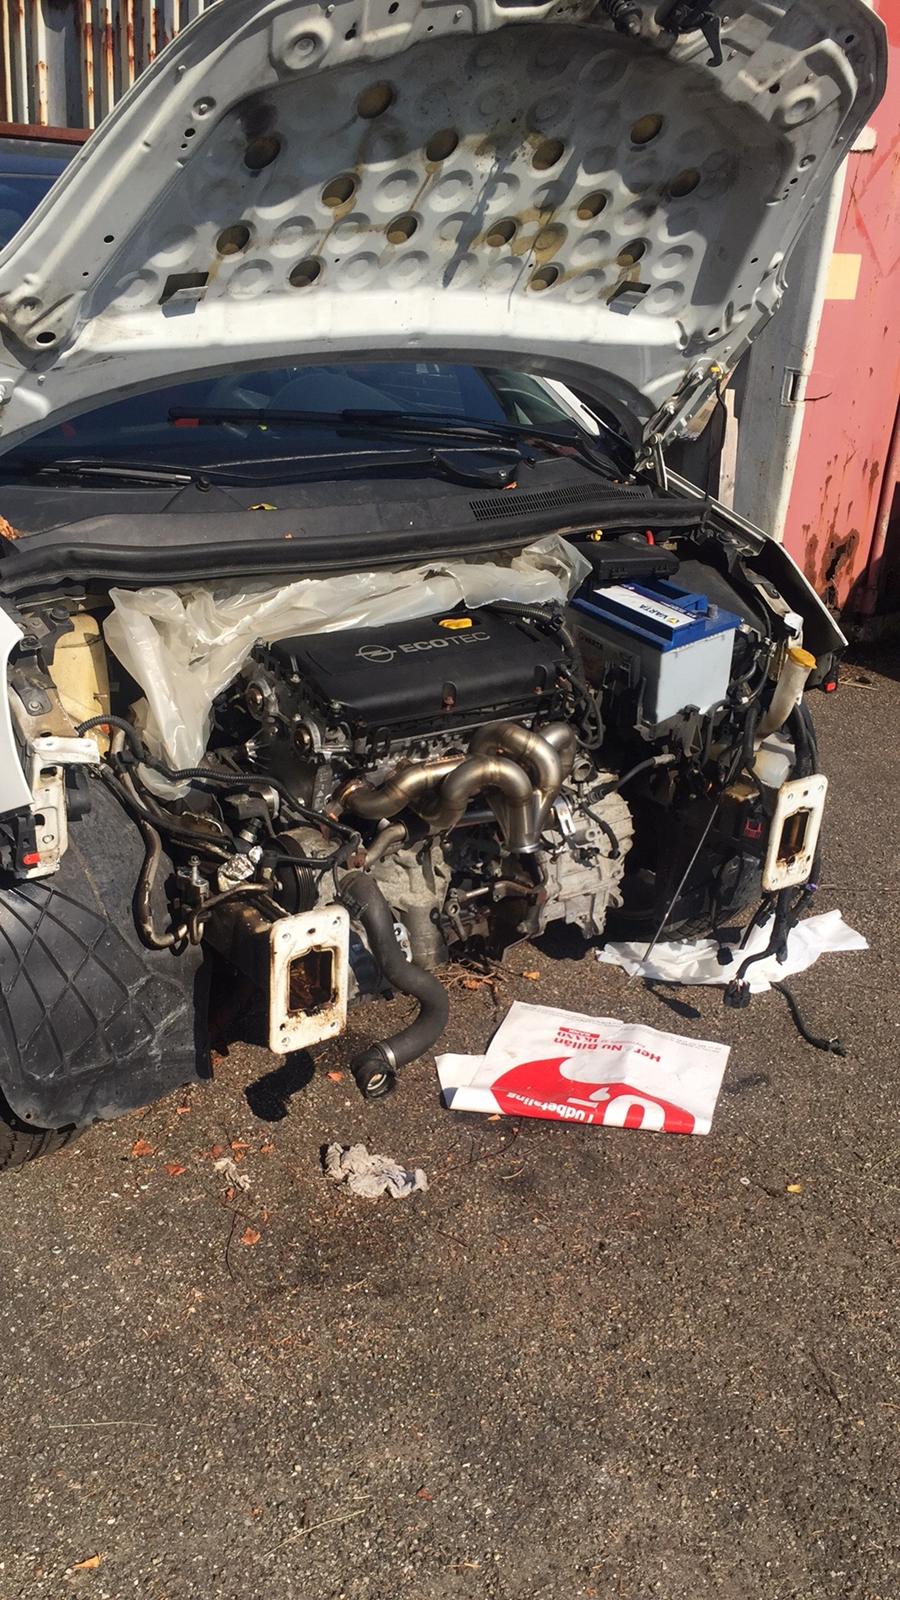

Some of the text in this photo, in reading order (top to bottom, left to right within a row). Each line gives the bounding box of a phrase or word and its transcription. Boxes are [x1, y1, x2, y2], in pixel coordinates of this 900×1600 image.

[639, 604, 669, 619] VARTA
[398, 631, 491, 653] ECOTEC
[554, 1037, 599, 1051] Billån
[603, 1044, 623, 1052] Nu
[634, 1048, 661, 1062] Her
